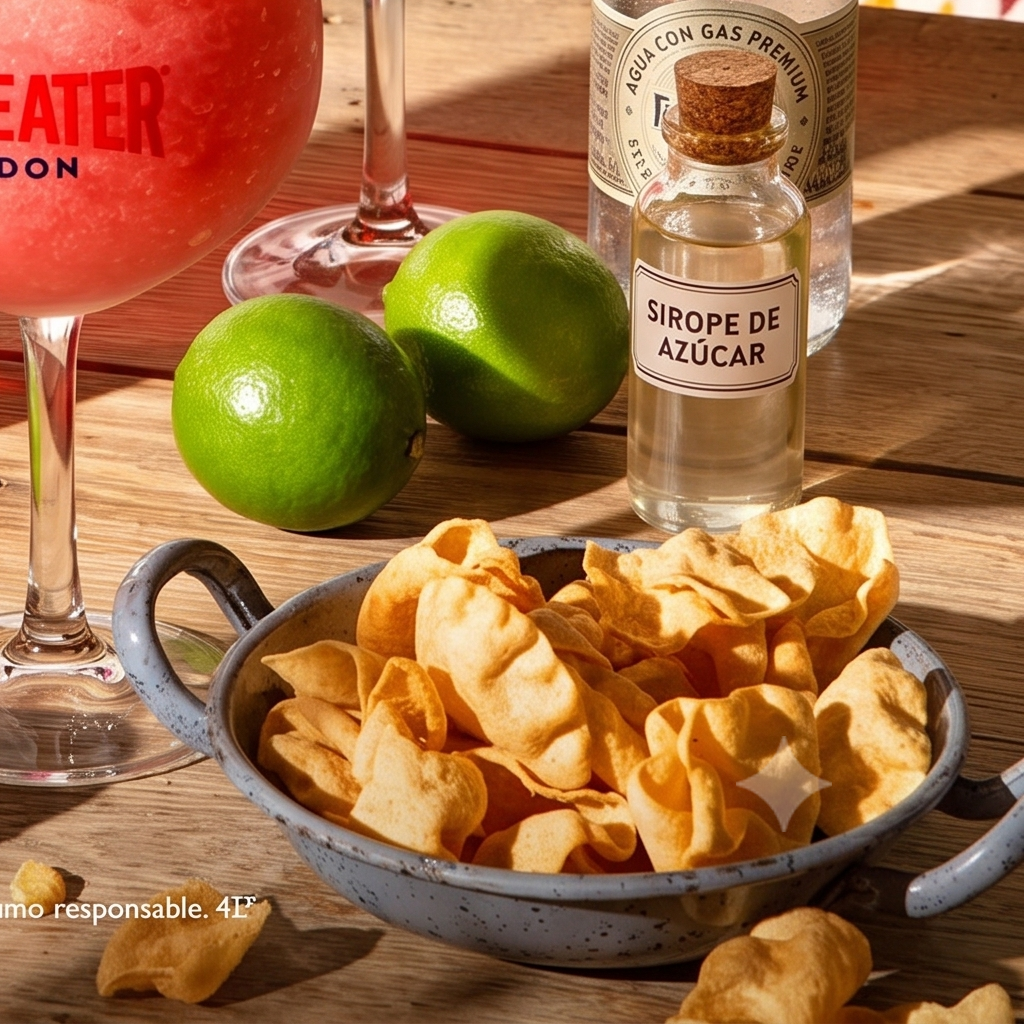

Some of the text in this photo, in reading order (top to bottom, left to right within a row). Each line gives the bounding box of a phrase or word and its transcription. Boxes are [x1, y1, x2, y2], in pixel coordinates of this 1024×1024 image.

[625, 23, 810, 104] AGUA CON GAS PREMIUM
[647, 298, 781, 336] SIROPE DE
[657, 336, 766, 368] AZÚCAR
